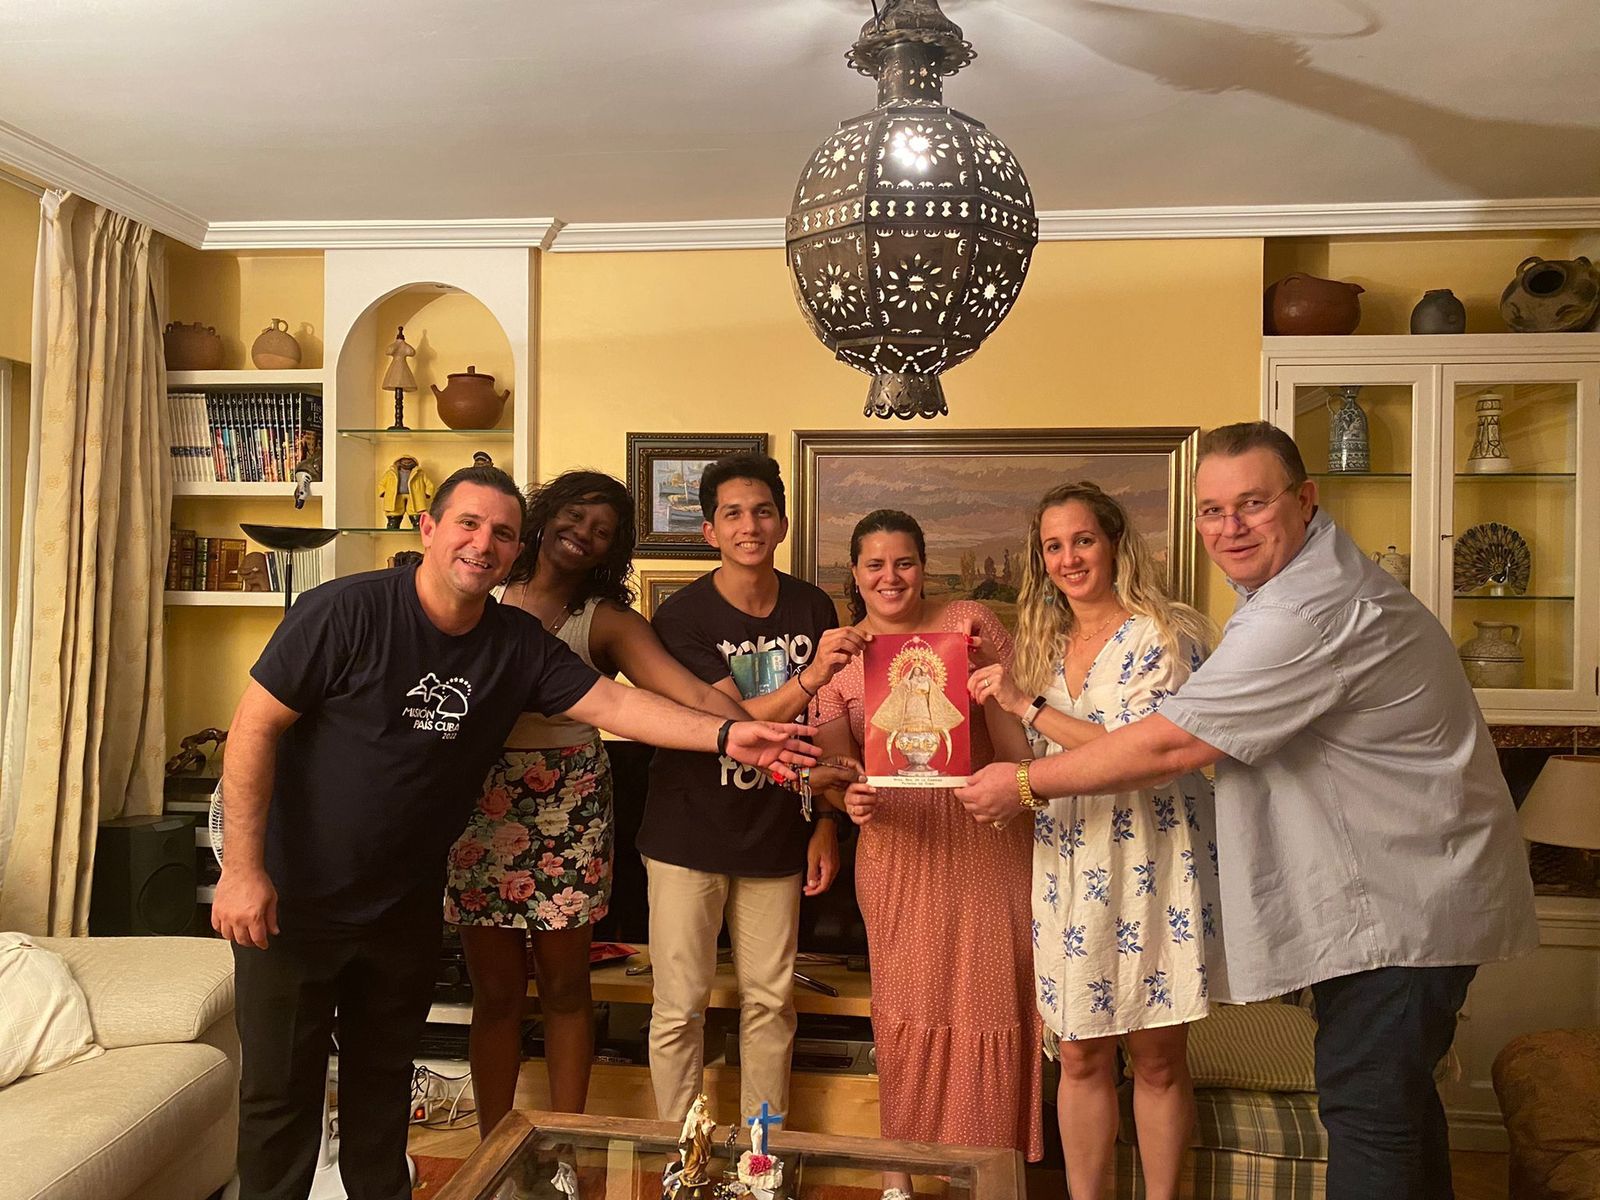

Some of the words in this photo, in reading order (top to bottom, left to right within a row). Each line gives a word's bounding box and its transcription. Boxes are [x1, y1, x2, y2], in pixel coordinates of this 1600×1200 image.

[402, 706, 436, 719] MISIÓN
[413, 718, 433, 730] PAÍS
[434, 721, 460, 732] CUBA
